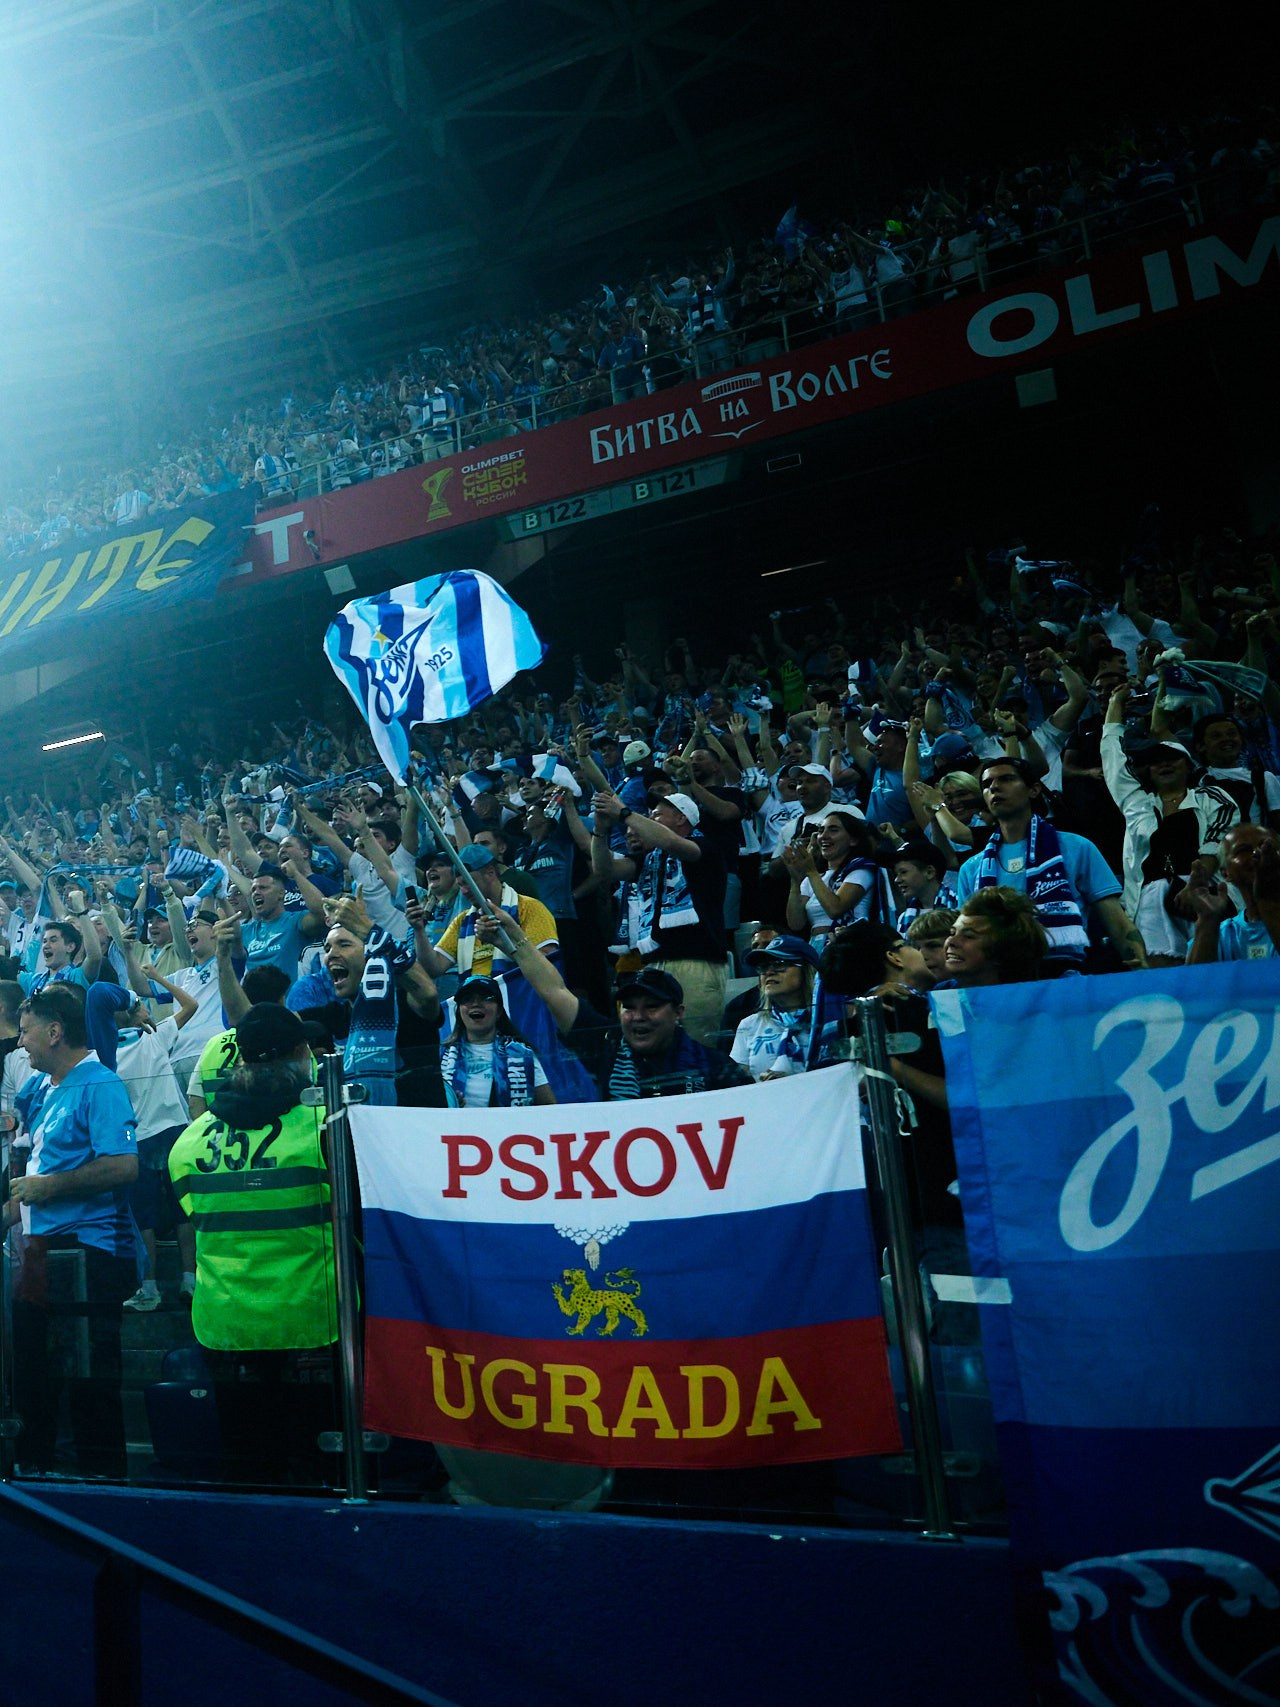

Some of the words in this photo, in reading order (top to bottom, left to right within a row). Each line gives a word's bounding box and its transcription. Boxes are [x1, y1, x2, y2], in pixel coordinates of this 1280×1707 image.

[461, 448, 525, 474] OLIMPBET
[463, 458, 527, 488] СУПЕР
[463, 471, 528, 502] КУБОК
[476, 489, 517, 507] РОССИИ
[635, 482, 650, 500] B
[659, 467, 697, 494] 121
[524, 511, 539, 529] B
[546, 498, 586, 524] 122
[424, 646, 454, 672] 1925
[195, 1118, 282, 1173] 352
[440, 1116, 745, 1202] PSKOV
[425, 1345, 822, 1440] UGRADA
